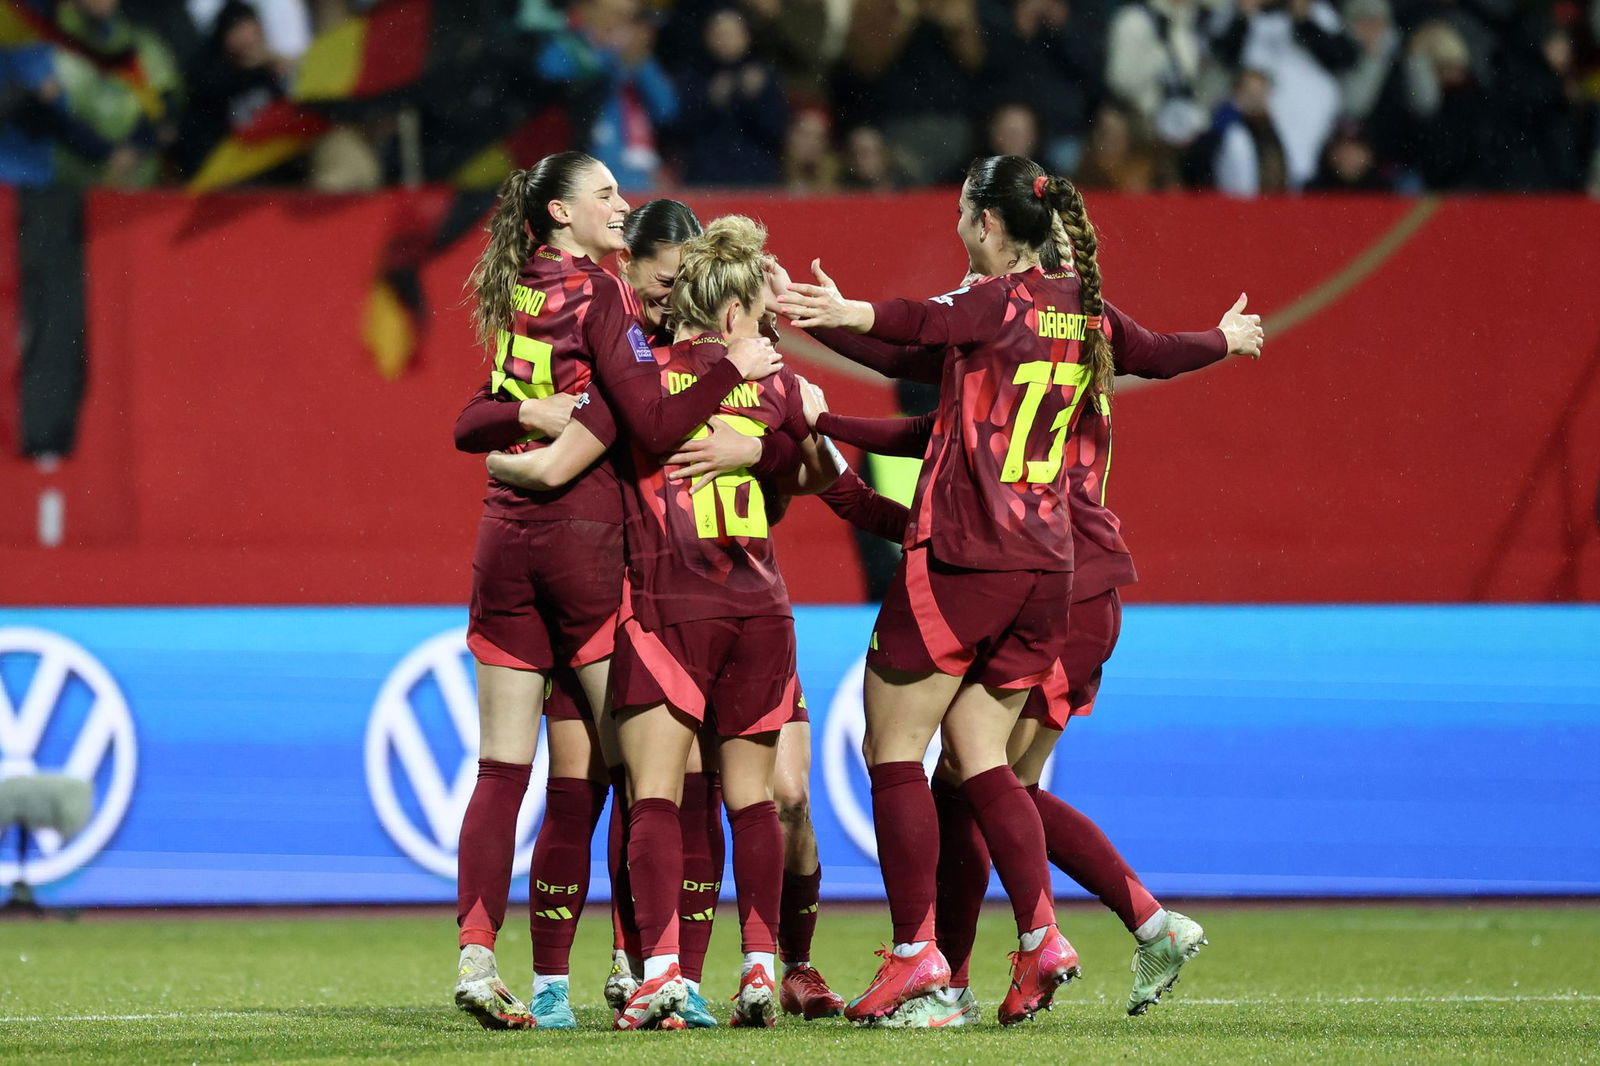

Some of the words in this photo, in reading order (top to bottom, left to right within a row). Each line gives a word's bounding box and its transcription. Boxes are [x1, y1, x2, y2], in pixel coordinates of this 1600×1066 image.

[1038, 305, 1088, 341] DÄBRITZ
[1000, 361, 1093, 484] 13
[683, 414, 769, 539] 16
[536, 879, 580, 895] DFB
[682, 879, 721, 893] DFB
